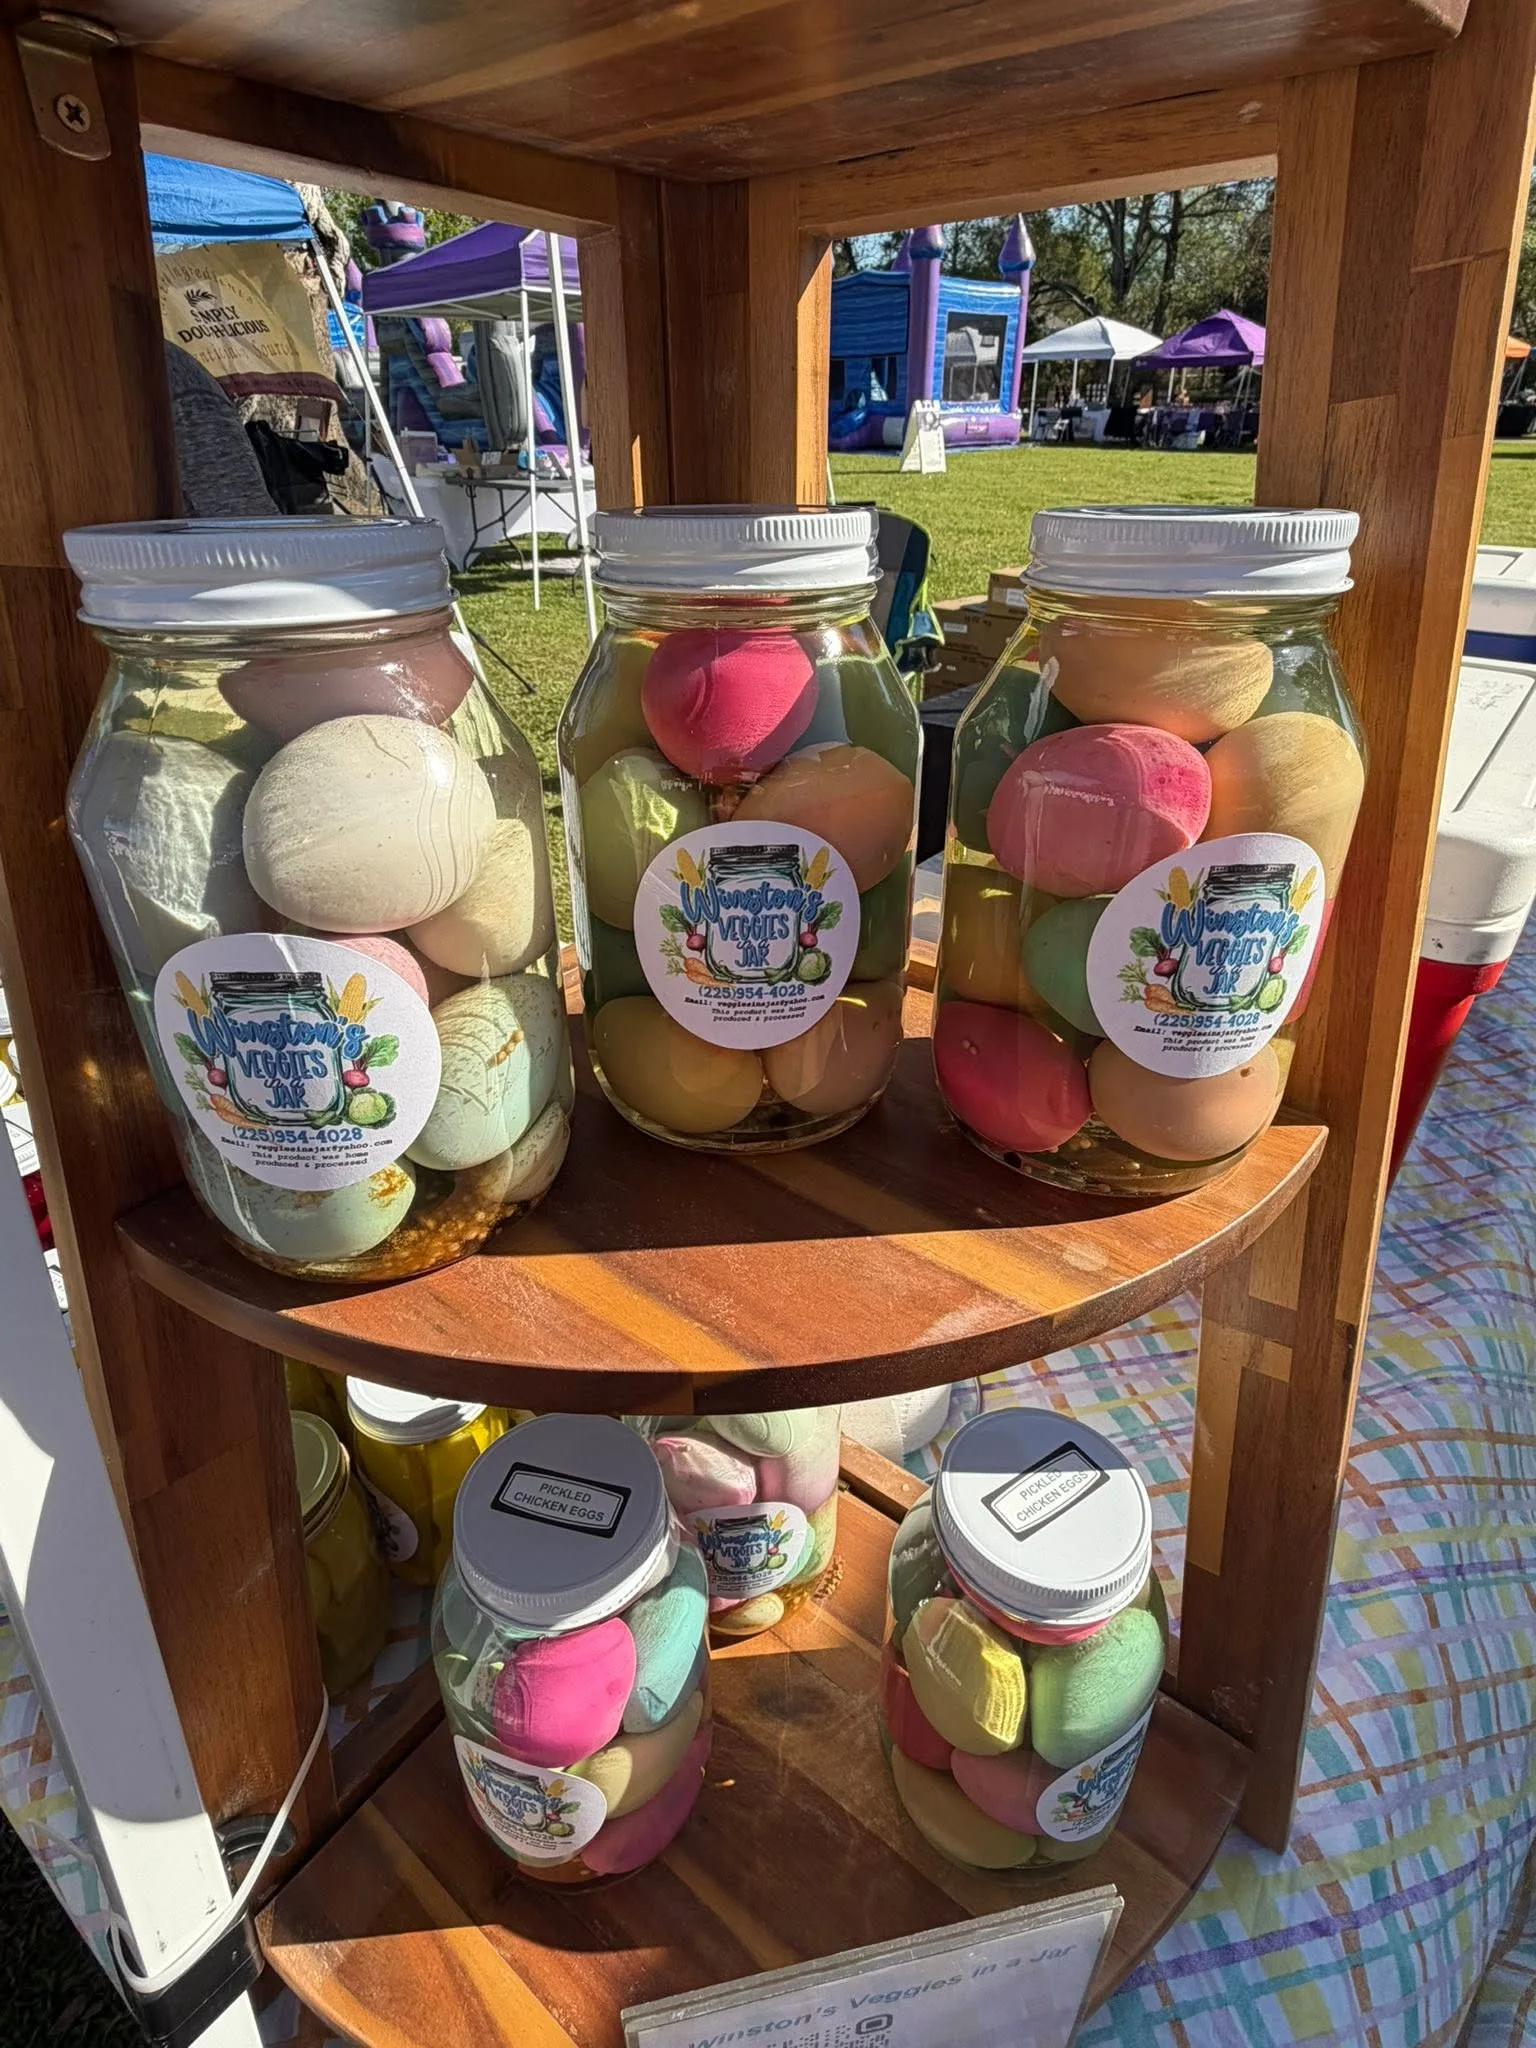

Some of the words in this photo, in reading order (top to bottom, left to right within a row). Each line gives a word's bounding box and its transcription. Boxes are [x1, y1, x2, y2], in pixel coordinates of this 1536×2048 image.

[190, 305, 240, 325] SMPLY
[177, 319, 270, 343] DOUH-LICIOUS
[680, 878, 824, 922] Winston's
[719, 914, 790, 941] VEGGIES
[1161, 899, 1299, 947] Winston's
[735, 945, 770, 967] JAR
[1196, 937, 1267, 966] VEGGIES
[698, 984, 805, 1000] (225)954-4028
[1203, 970, 1240, 994] JAR
[763, 1012, 805, 1023] processed
[1153, 1012, 1260, 1028] (225)954-4028
[187, 1006, 370, 1059] Winston's
[1133, 1025, 1166, 1035] Email:
[1186, 1038, 1219, 1046] product
[1214, 1043, 1252, 1052] processed
[236, 1049, 328, 1079] VEGGIES
[265, 1086, 309, 1108] JAR
[221, 1137, 250, 1149] Email:
[232, 1126, 363, 1143] (225)954-4028
[252, 1151, 273, 1159] This
[277, 1153, 315, 1162] product
[255, 1159, 299, 1168] produced
[315, 1158, 368, 1169] processed
[539, 1482, 592, 1503] PICKLED
[1019, 1468, 1062, 1501] PICKLED
[513, 1491, 567, 1513] CHICKEN
[569, 1505, 605, 1522] EGGS
[1016, 1488, 1061, 1522] CHICKEN
[1060, 1471, 1088, 1493] EGGS
[850, 1974, 963, 2009] Veggies
[1005, 1957, 1021, 1968] a
[1030, 1944, 1077, 1963] Jar
